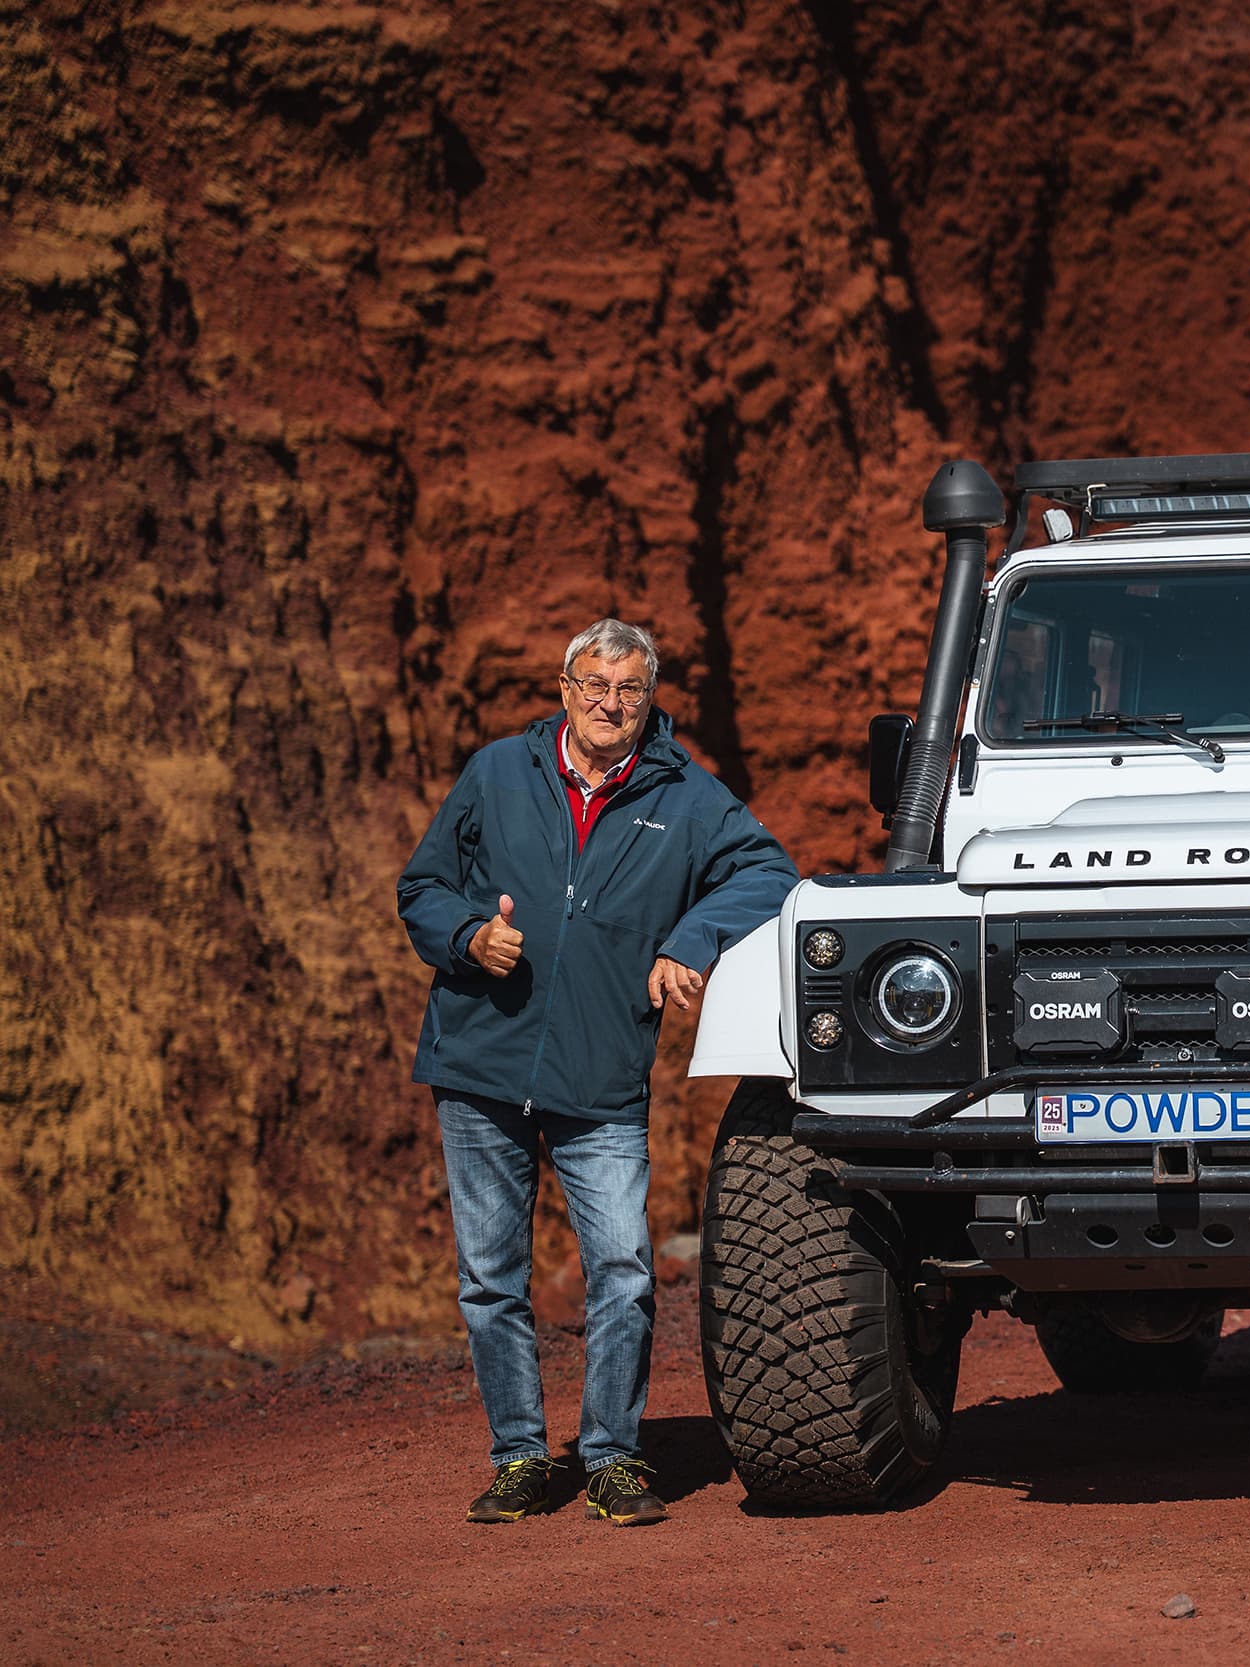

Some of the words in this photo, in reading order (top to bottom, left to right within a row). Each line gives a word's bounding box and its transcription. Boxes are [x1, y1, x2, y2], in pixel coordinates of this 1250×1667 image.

[1013, 850, 1152, 870] LAND
[1051, 971, 1081, 980] OSRAM
[1029, 1003, 1101, 1020] OSRAM
[1044, 1102, 1061, 1119] 25
[1043, 1124, 1060, 1132] 2025
